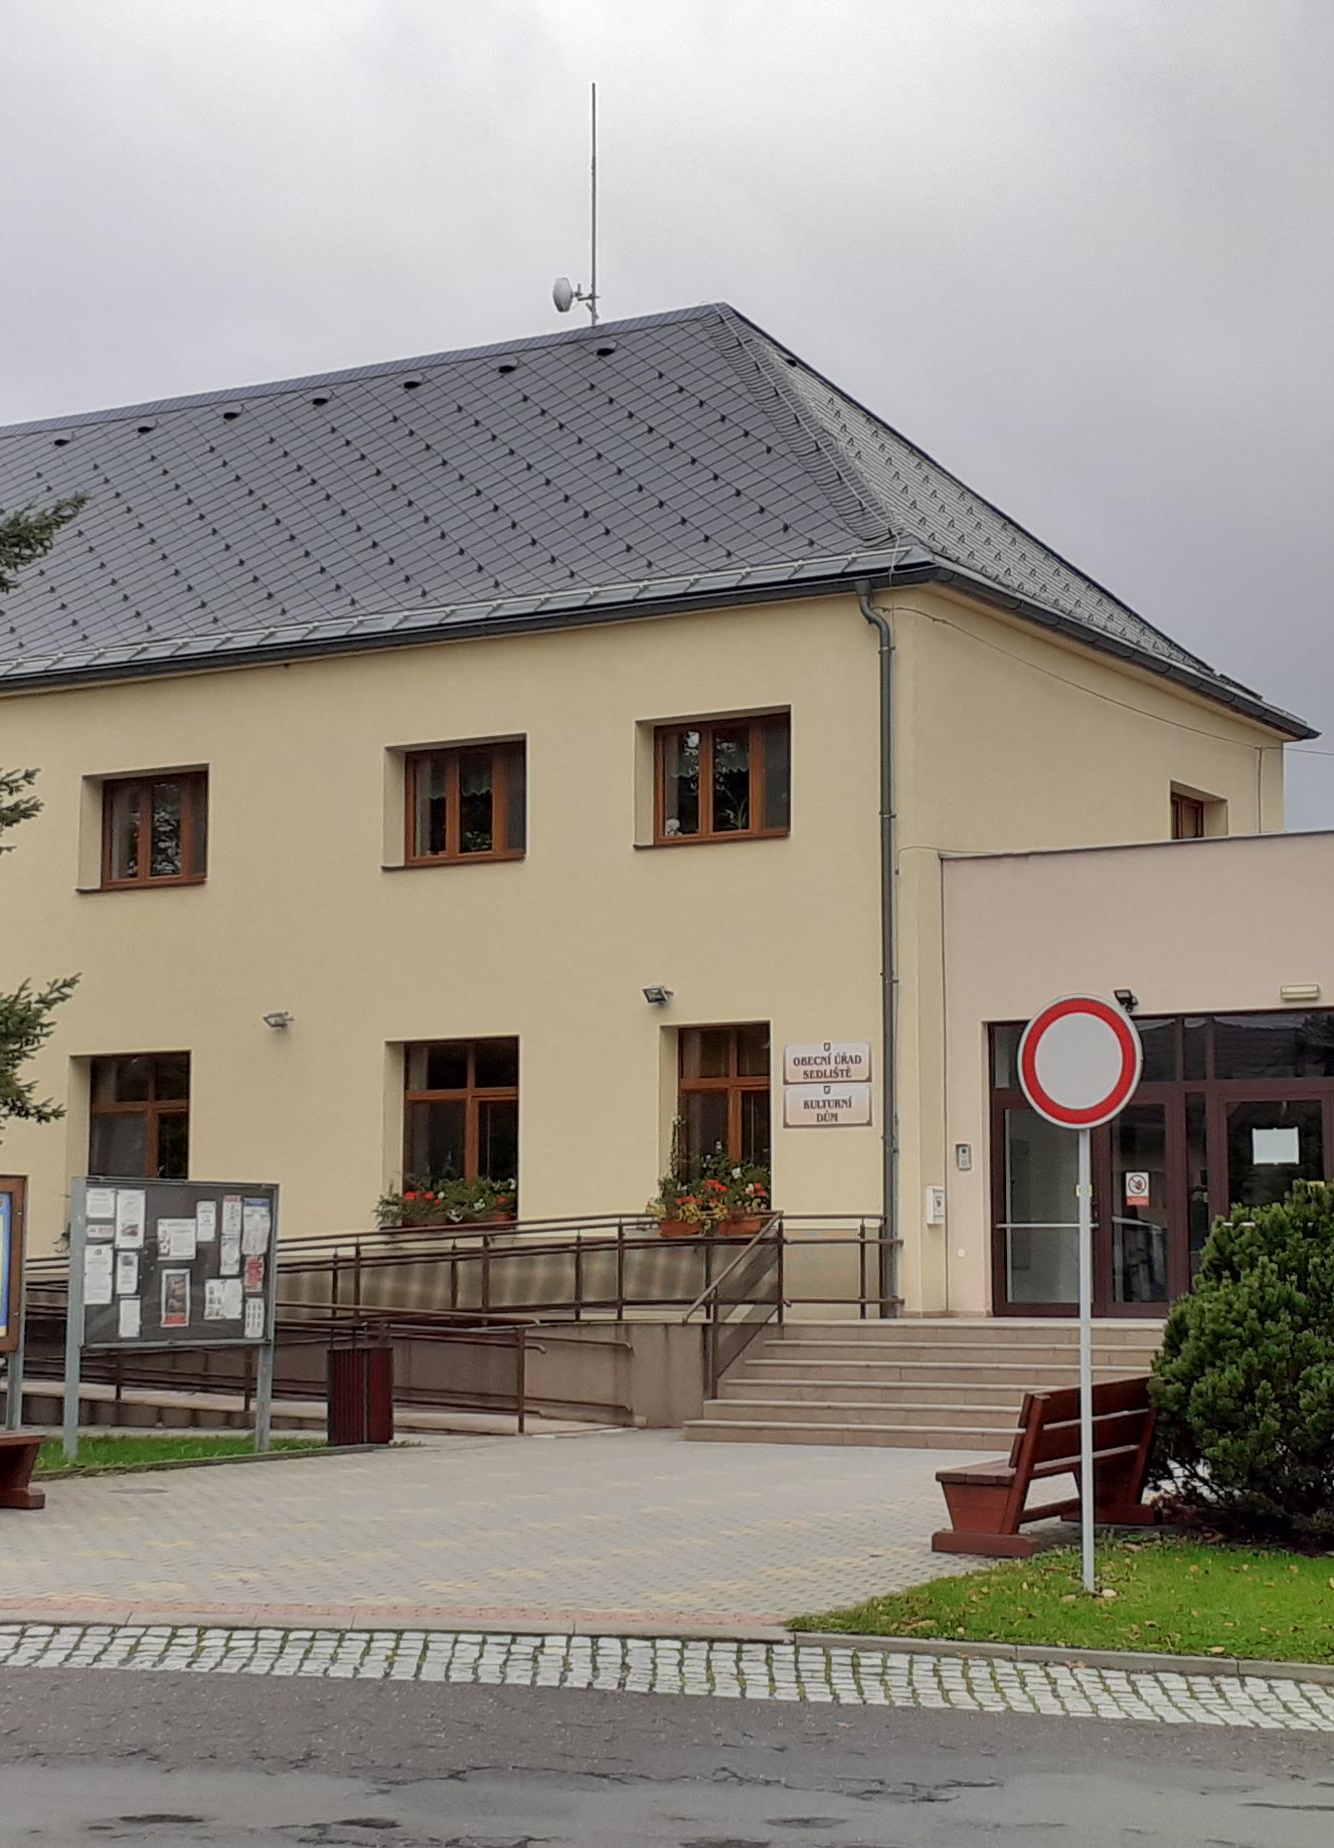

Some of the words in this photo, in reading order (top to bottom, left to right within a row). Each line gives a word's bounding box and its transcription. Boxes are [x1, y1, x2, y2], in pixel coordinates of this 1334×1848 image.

[793, 1053, 831, 1066] OBECNÍ
[835, 1052, 862, 1064] ÚŘAD
[803, 1067, 851, 1079] SEDLIŠTĚ
[803, 1096, 852, 1109] KULTURNÍ
[816, 1110, 838, 1122] DŮM
